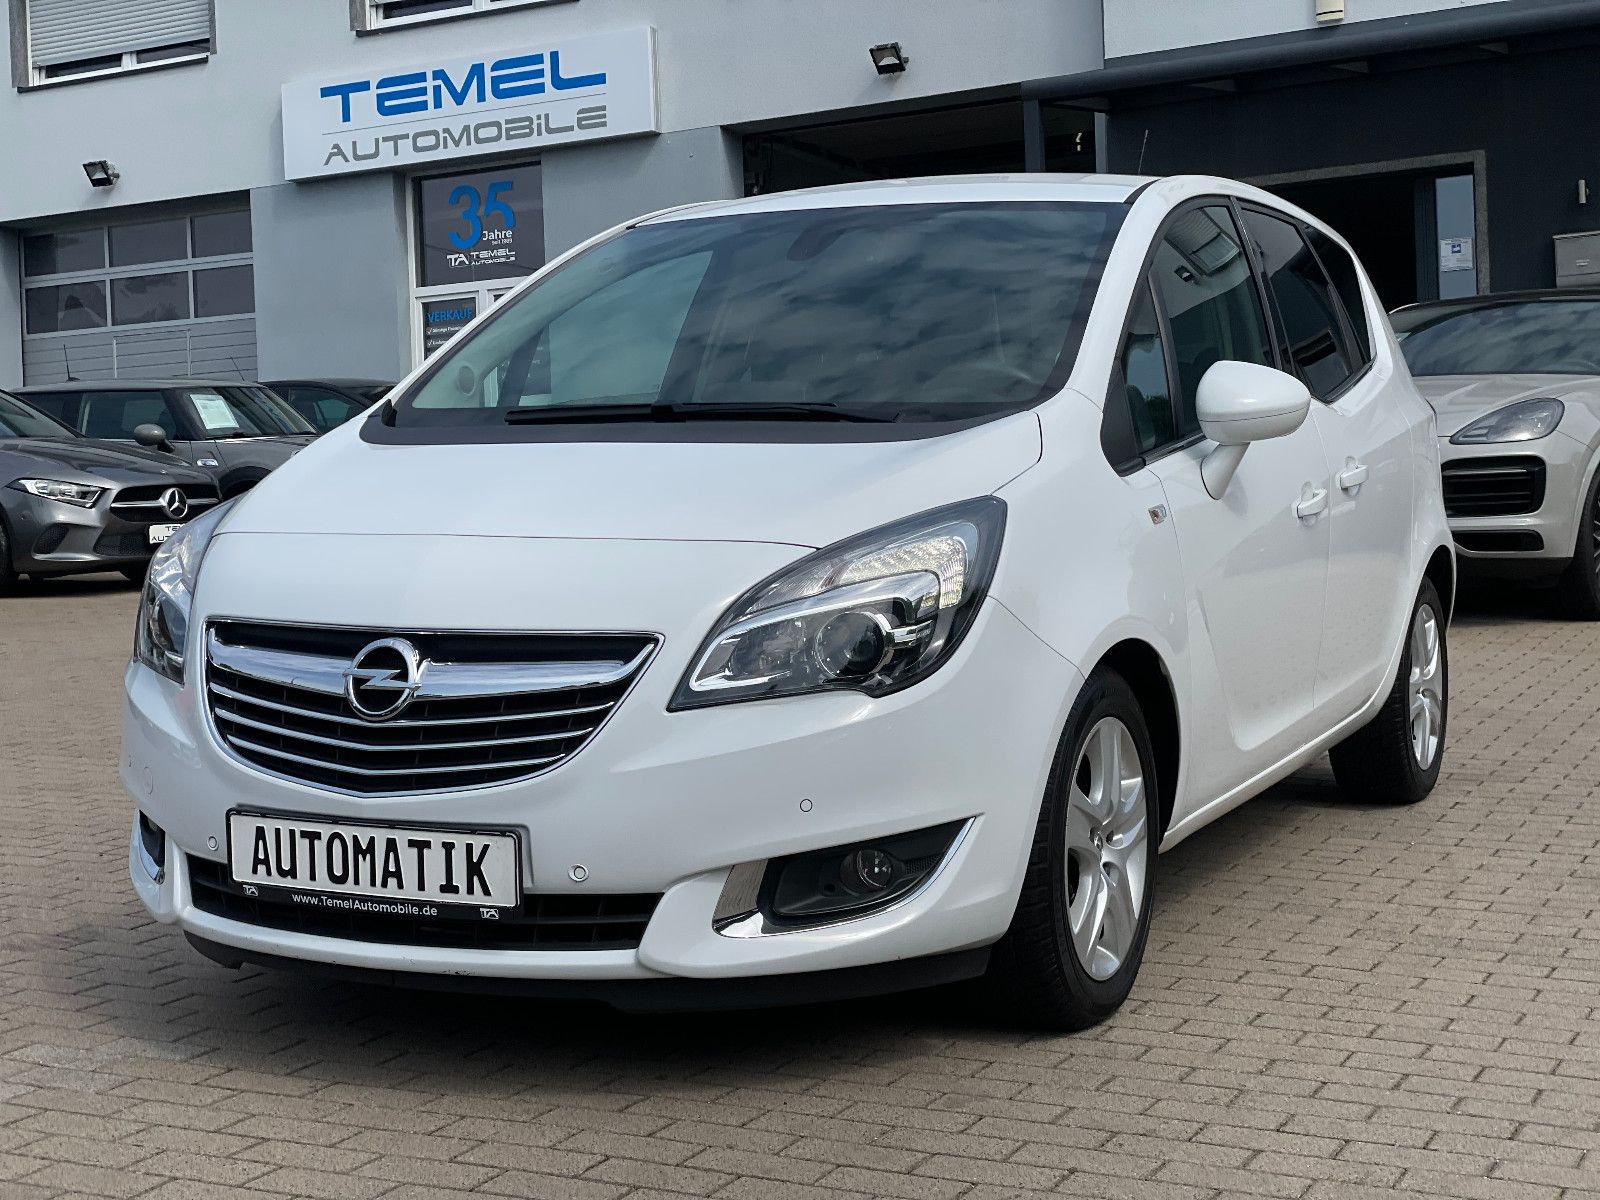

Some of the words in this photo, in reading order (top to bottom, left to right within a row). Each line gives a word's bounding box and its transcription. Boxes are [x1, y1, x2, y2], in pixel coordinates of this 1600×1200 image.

[320, 50, 607, 123] TEMEL
[448, 180, 516, 250] 35
[482, 229, 513, 241] Jahre
[446, 253, 470, 268] TA
[470, 248, 516, 259] TEMEL
[427, 307, 473, 322] VERKAUF
[251, 825, 492, 897] AUTOMATIK
[291, 893, 438, 917] www.TemelAutomobile.de
